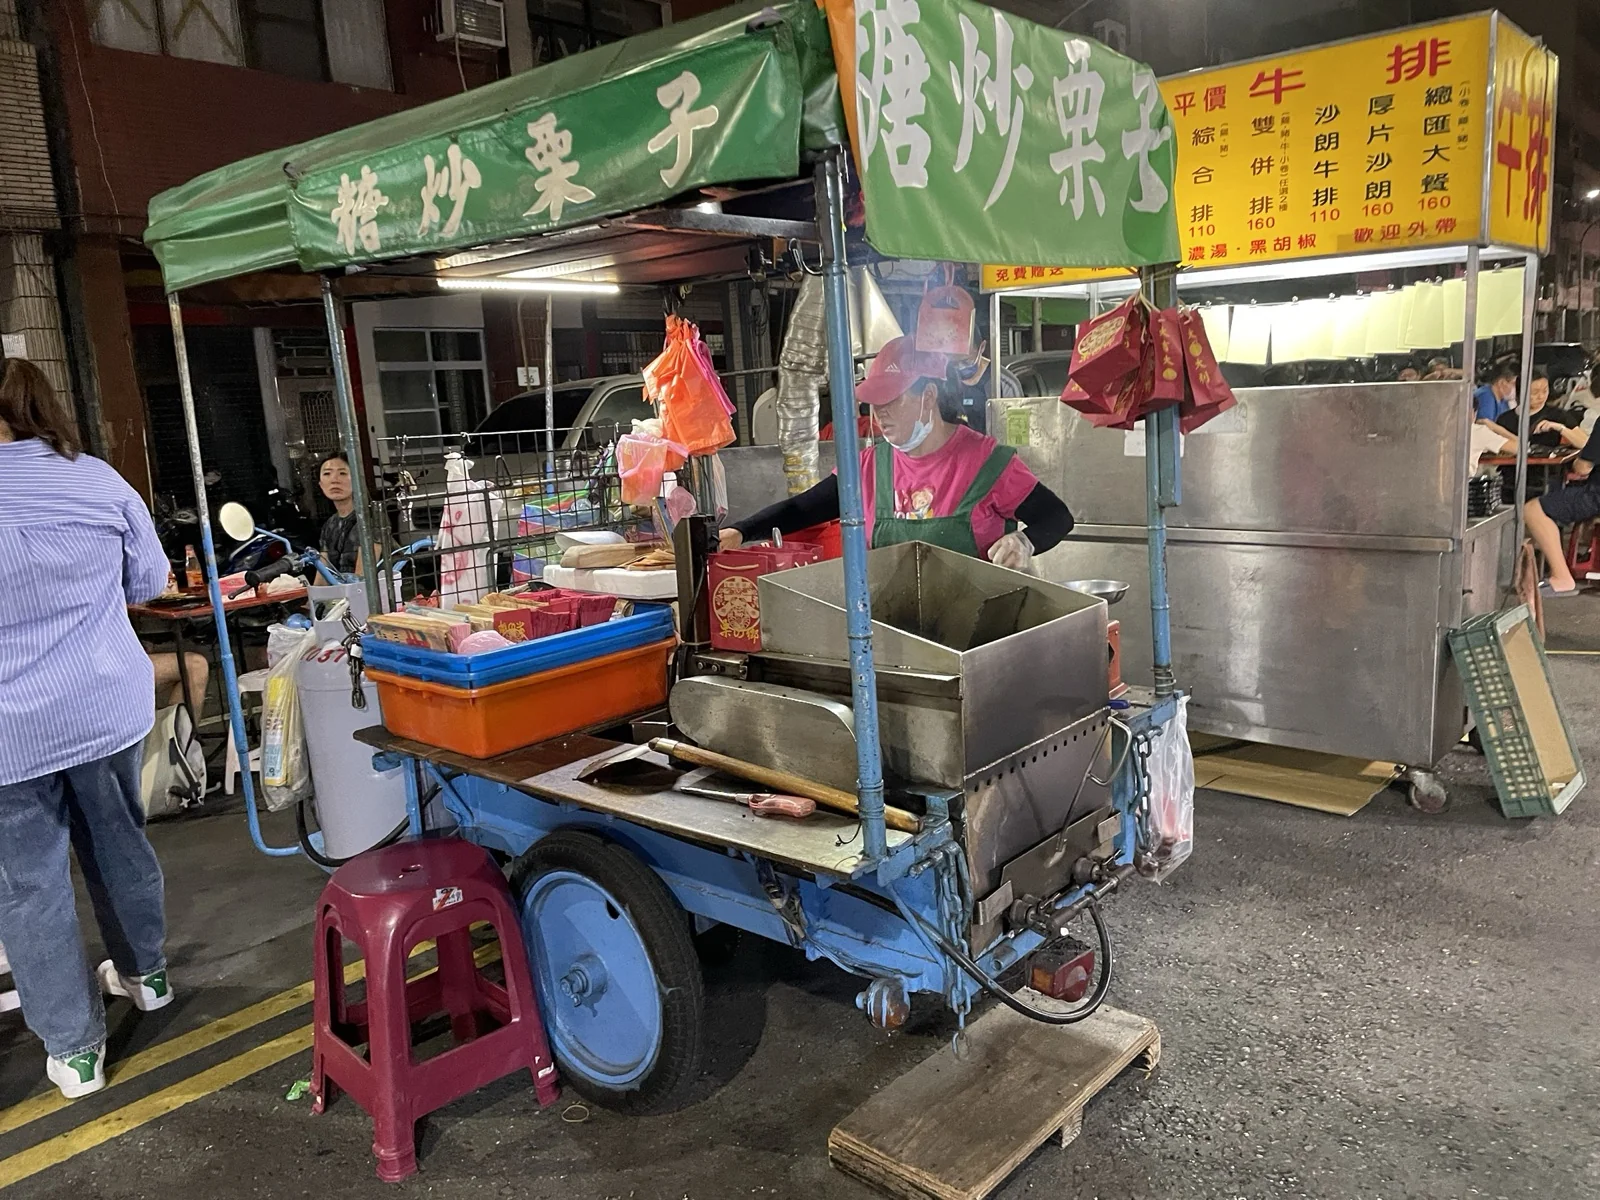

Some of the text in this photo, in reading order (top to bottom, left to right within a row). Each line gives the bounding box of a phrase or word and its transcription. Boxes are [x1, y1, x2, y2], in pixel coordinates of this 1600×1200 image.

[1173, 37, 1453, 117] 平價 牛排
[330, 69, 720, 256] 糖炒栗子
[1190, 127, 1216, 223] 綜合排
[1248, 115, 1275, 216] 雙併排
[1312, 104, 1341, 207] 沙朗牛排
[1364, 93, 1396, 201] 厚片沙朗
[1420, 85, 1453, 194] 總匯大餐
[1188, 223, 1216, 238] 110
[1247, 216, 1276, 231] 160
[1310, 207, 1340, 222] 110
[1353, 217, 1458, 244] 歡迎外帶
[1362, 201, 1394, 216] 160
[1418, 195, 1451, 210] 160
